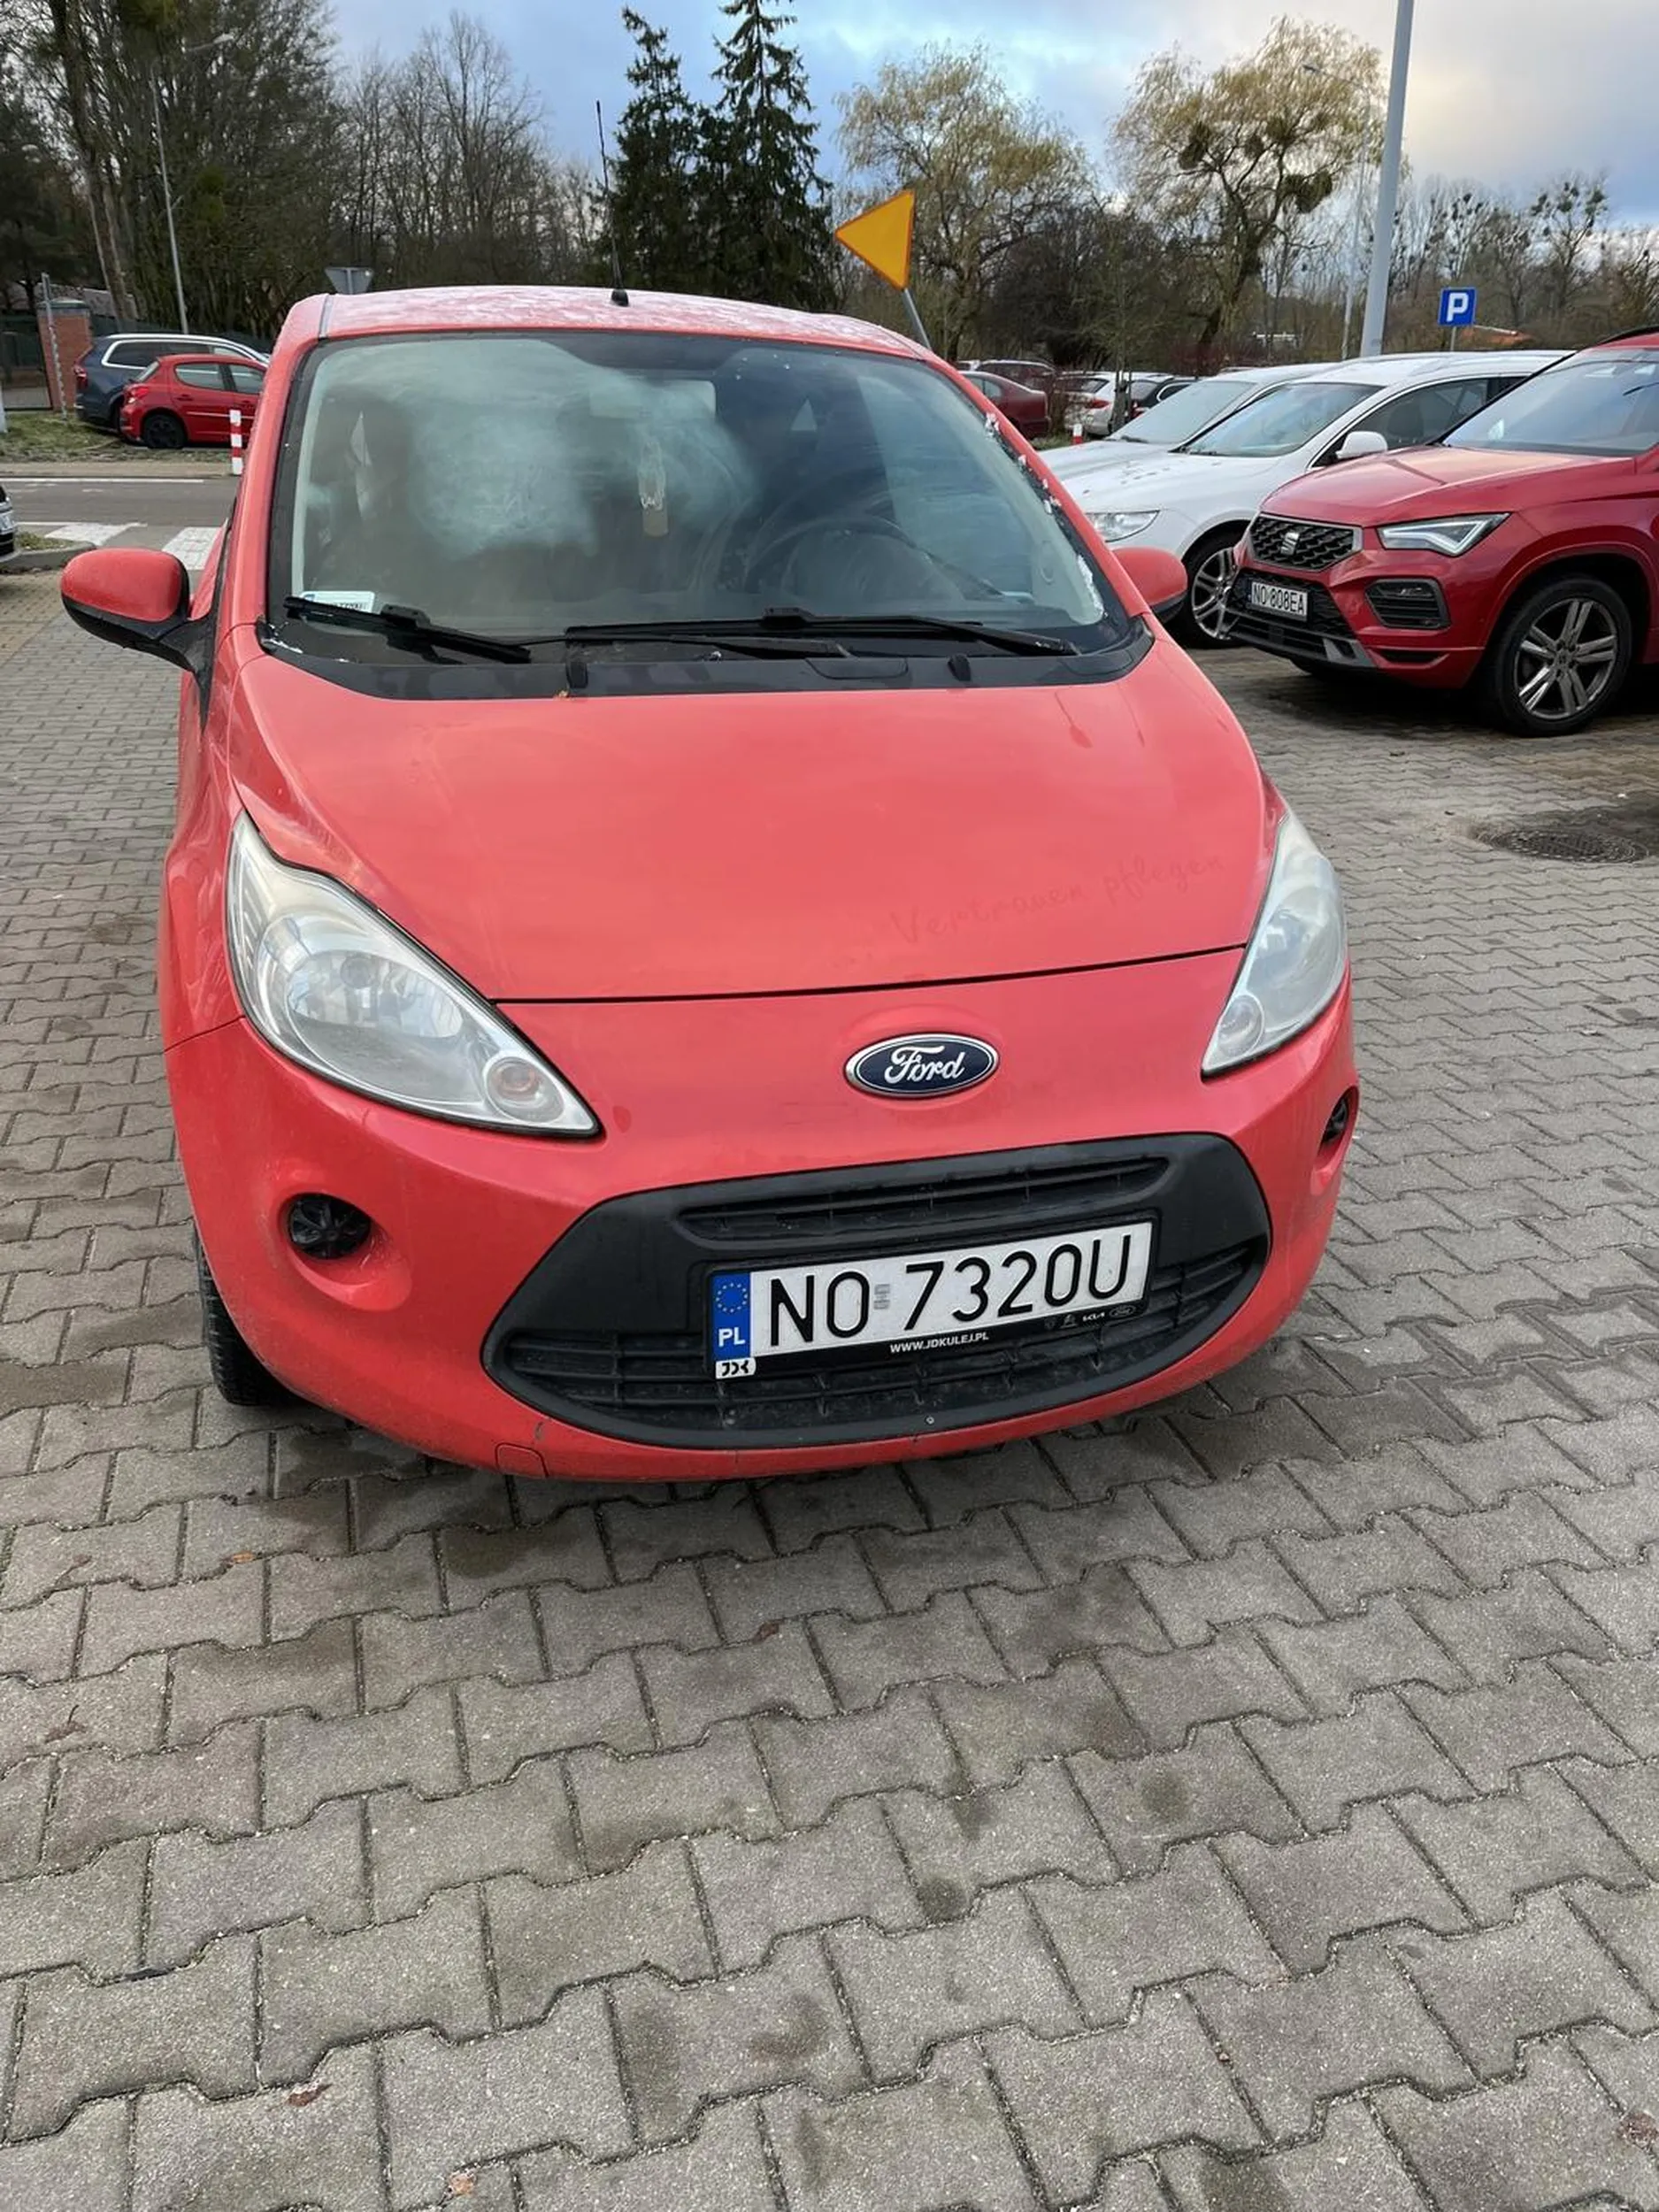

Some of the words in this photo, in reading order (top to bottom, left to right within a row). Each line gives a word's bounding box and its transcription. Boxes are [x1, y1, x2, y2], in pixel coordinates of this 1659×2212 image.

[1446, 292, 1469, 322] P
[1253, 584, 1266, 605] NO
[889, 883, 1089, 945] Vertrauen
[1102, 854, 1225, 906] pflegen
[885, 1045, 966, 1084] Ford
[770, 1271, 871, 1347] NO
[903, 1234, 1132, 1331] 7320U
[718, 1327, 746, 1347] PL
[888, 1333, 989, 1354] WWW.JDKULEJ.PL
